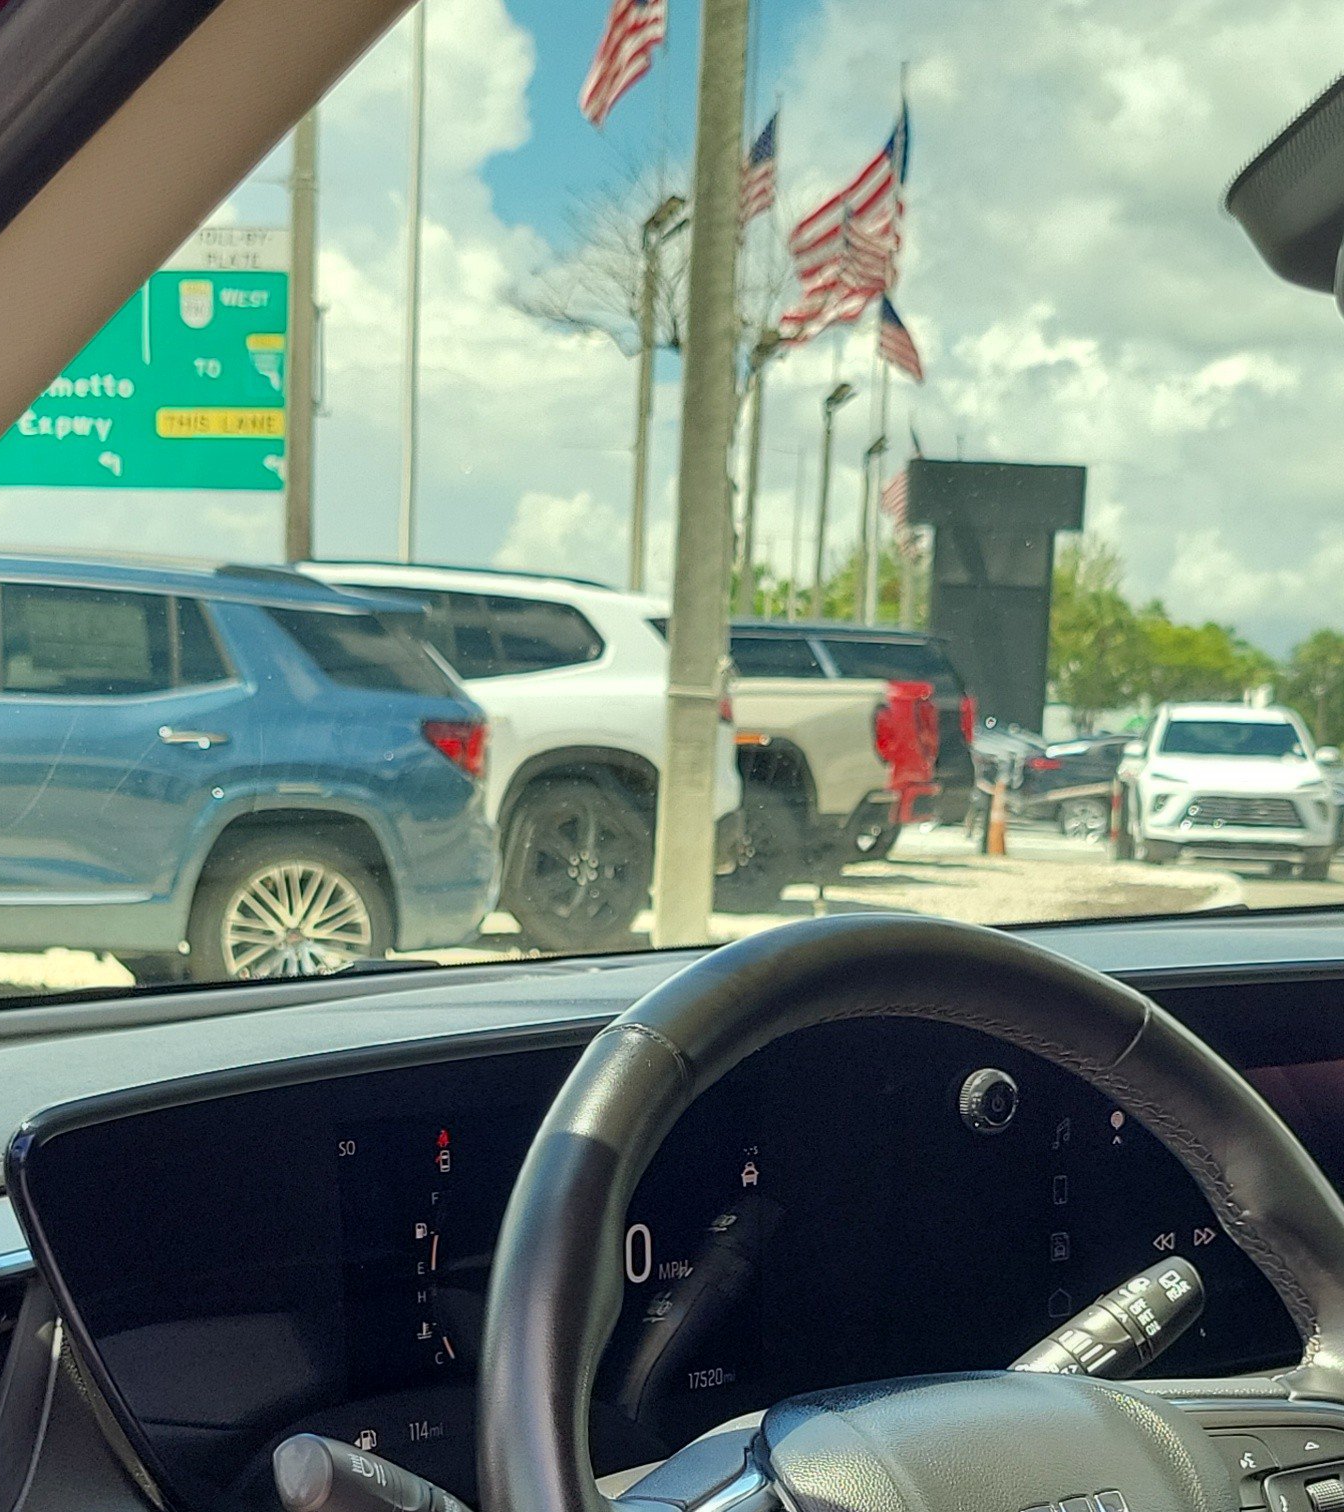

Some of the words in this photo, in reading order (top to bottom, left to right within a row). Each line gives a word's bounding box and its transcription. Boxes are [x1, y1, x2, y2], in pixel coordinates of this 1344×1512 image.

[219, 288, 269, 308] WEST
[194, 357, 222, 379] TO
[47, 373, 135, 398] metto
[167, 415, 208, 433] THIS
[222, 415, 276, 434] LANE
[625, 1223, 652, 1284] 0
[658, 1260, 690, 1281] MPH
[1165, 1279, 1192, 1302] REAR
